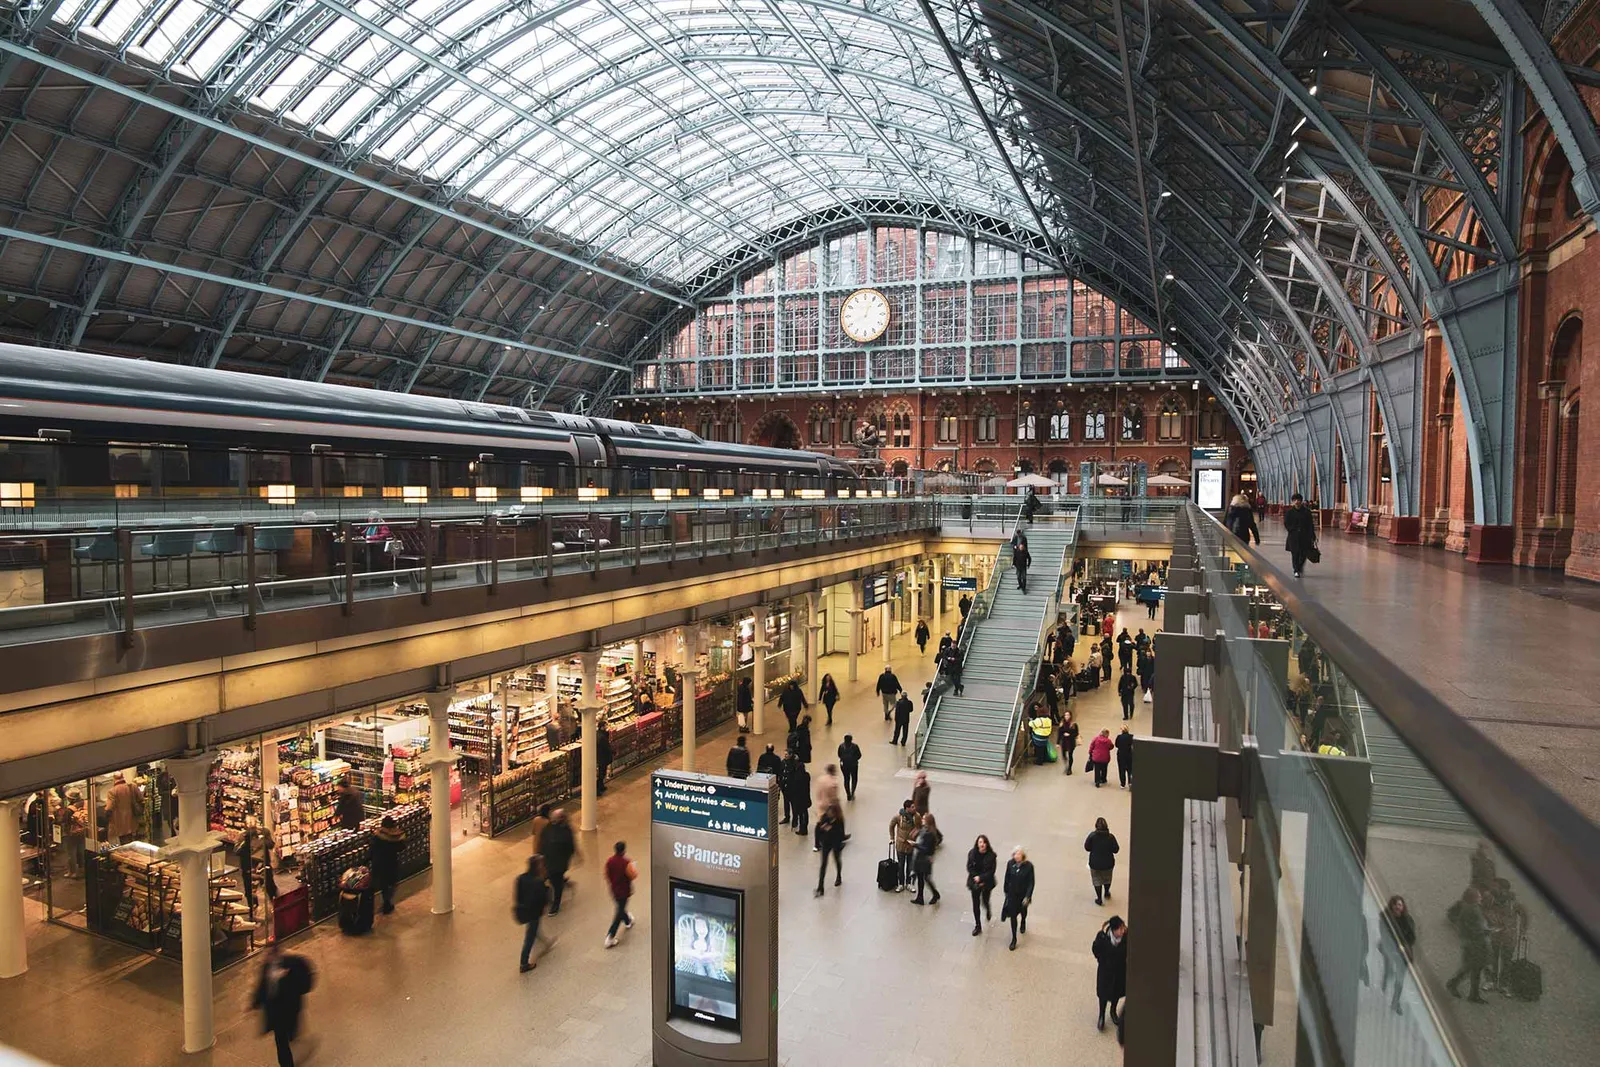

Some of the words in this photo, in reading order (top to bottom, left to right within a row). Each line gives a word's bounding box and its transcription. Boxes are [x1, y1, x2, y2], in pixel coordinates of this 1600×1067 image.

[664, 780, 706, 793] Underground
[664, 791, 690, 801] Arrivals
[690, 795, 718, 806] Arrivées
[665, 802, 678, 812] Way
[679, 805, 690, 813] out
[733, 823, 755, 834] Toilets
